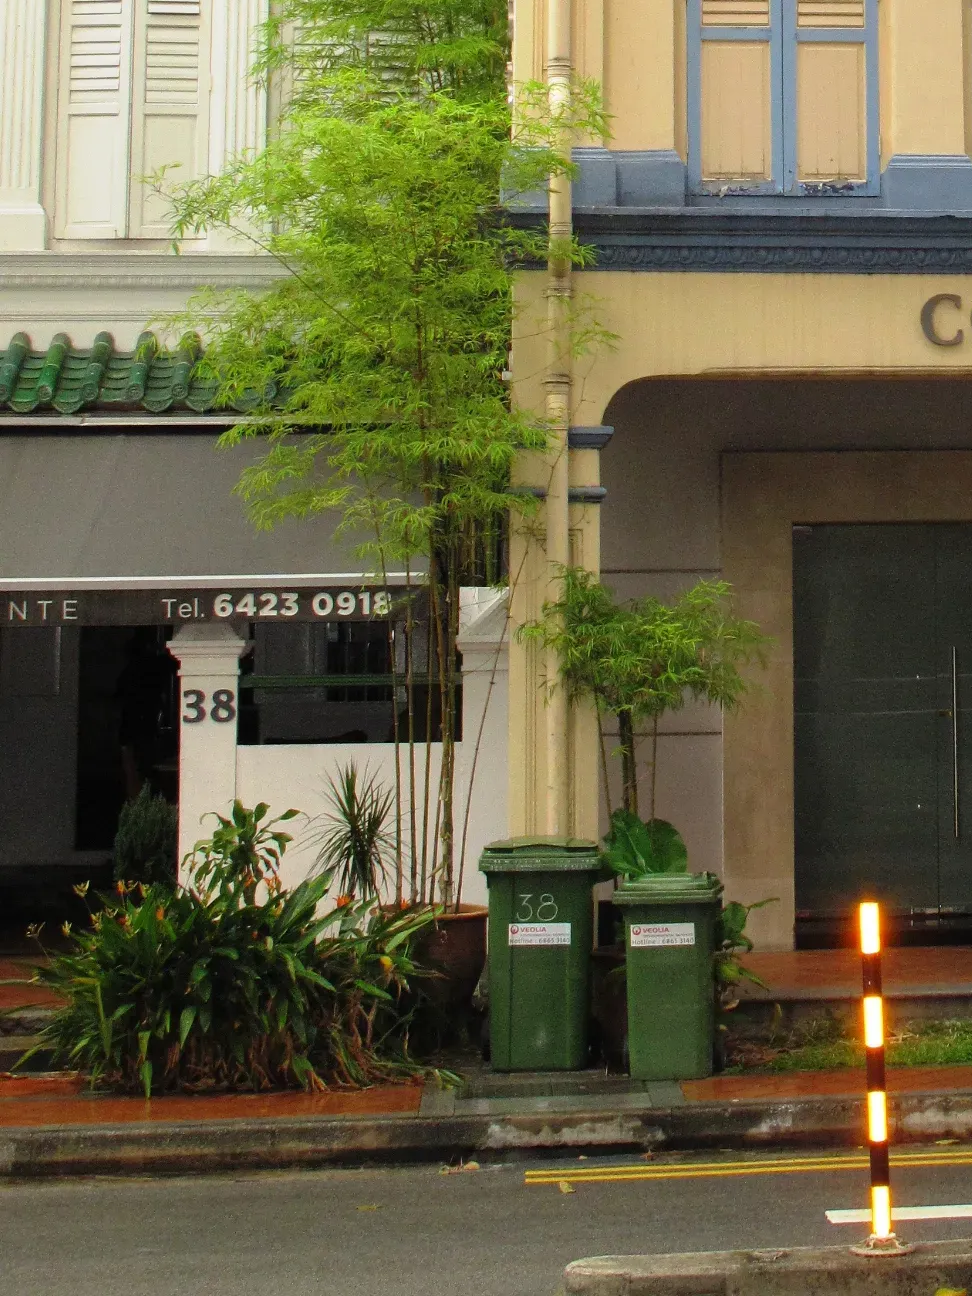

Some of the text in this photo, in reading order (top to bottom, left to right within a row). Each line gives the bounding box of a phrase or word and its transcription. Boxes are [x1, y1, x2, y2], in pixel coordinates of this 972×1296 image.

[162, 598, 205, 619] Tel.
[213, 591, 299, 618] 6423
[312, 591, 392, 616] 0918
[182, 689, 236, 723] 38
[516, 893, 558, 921] 38
